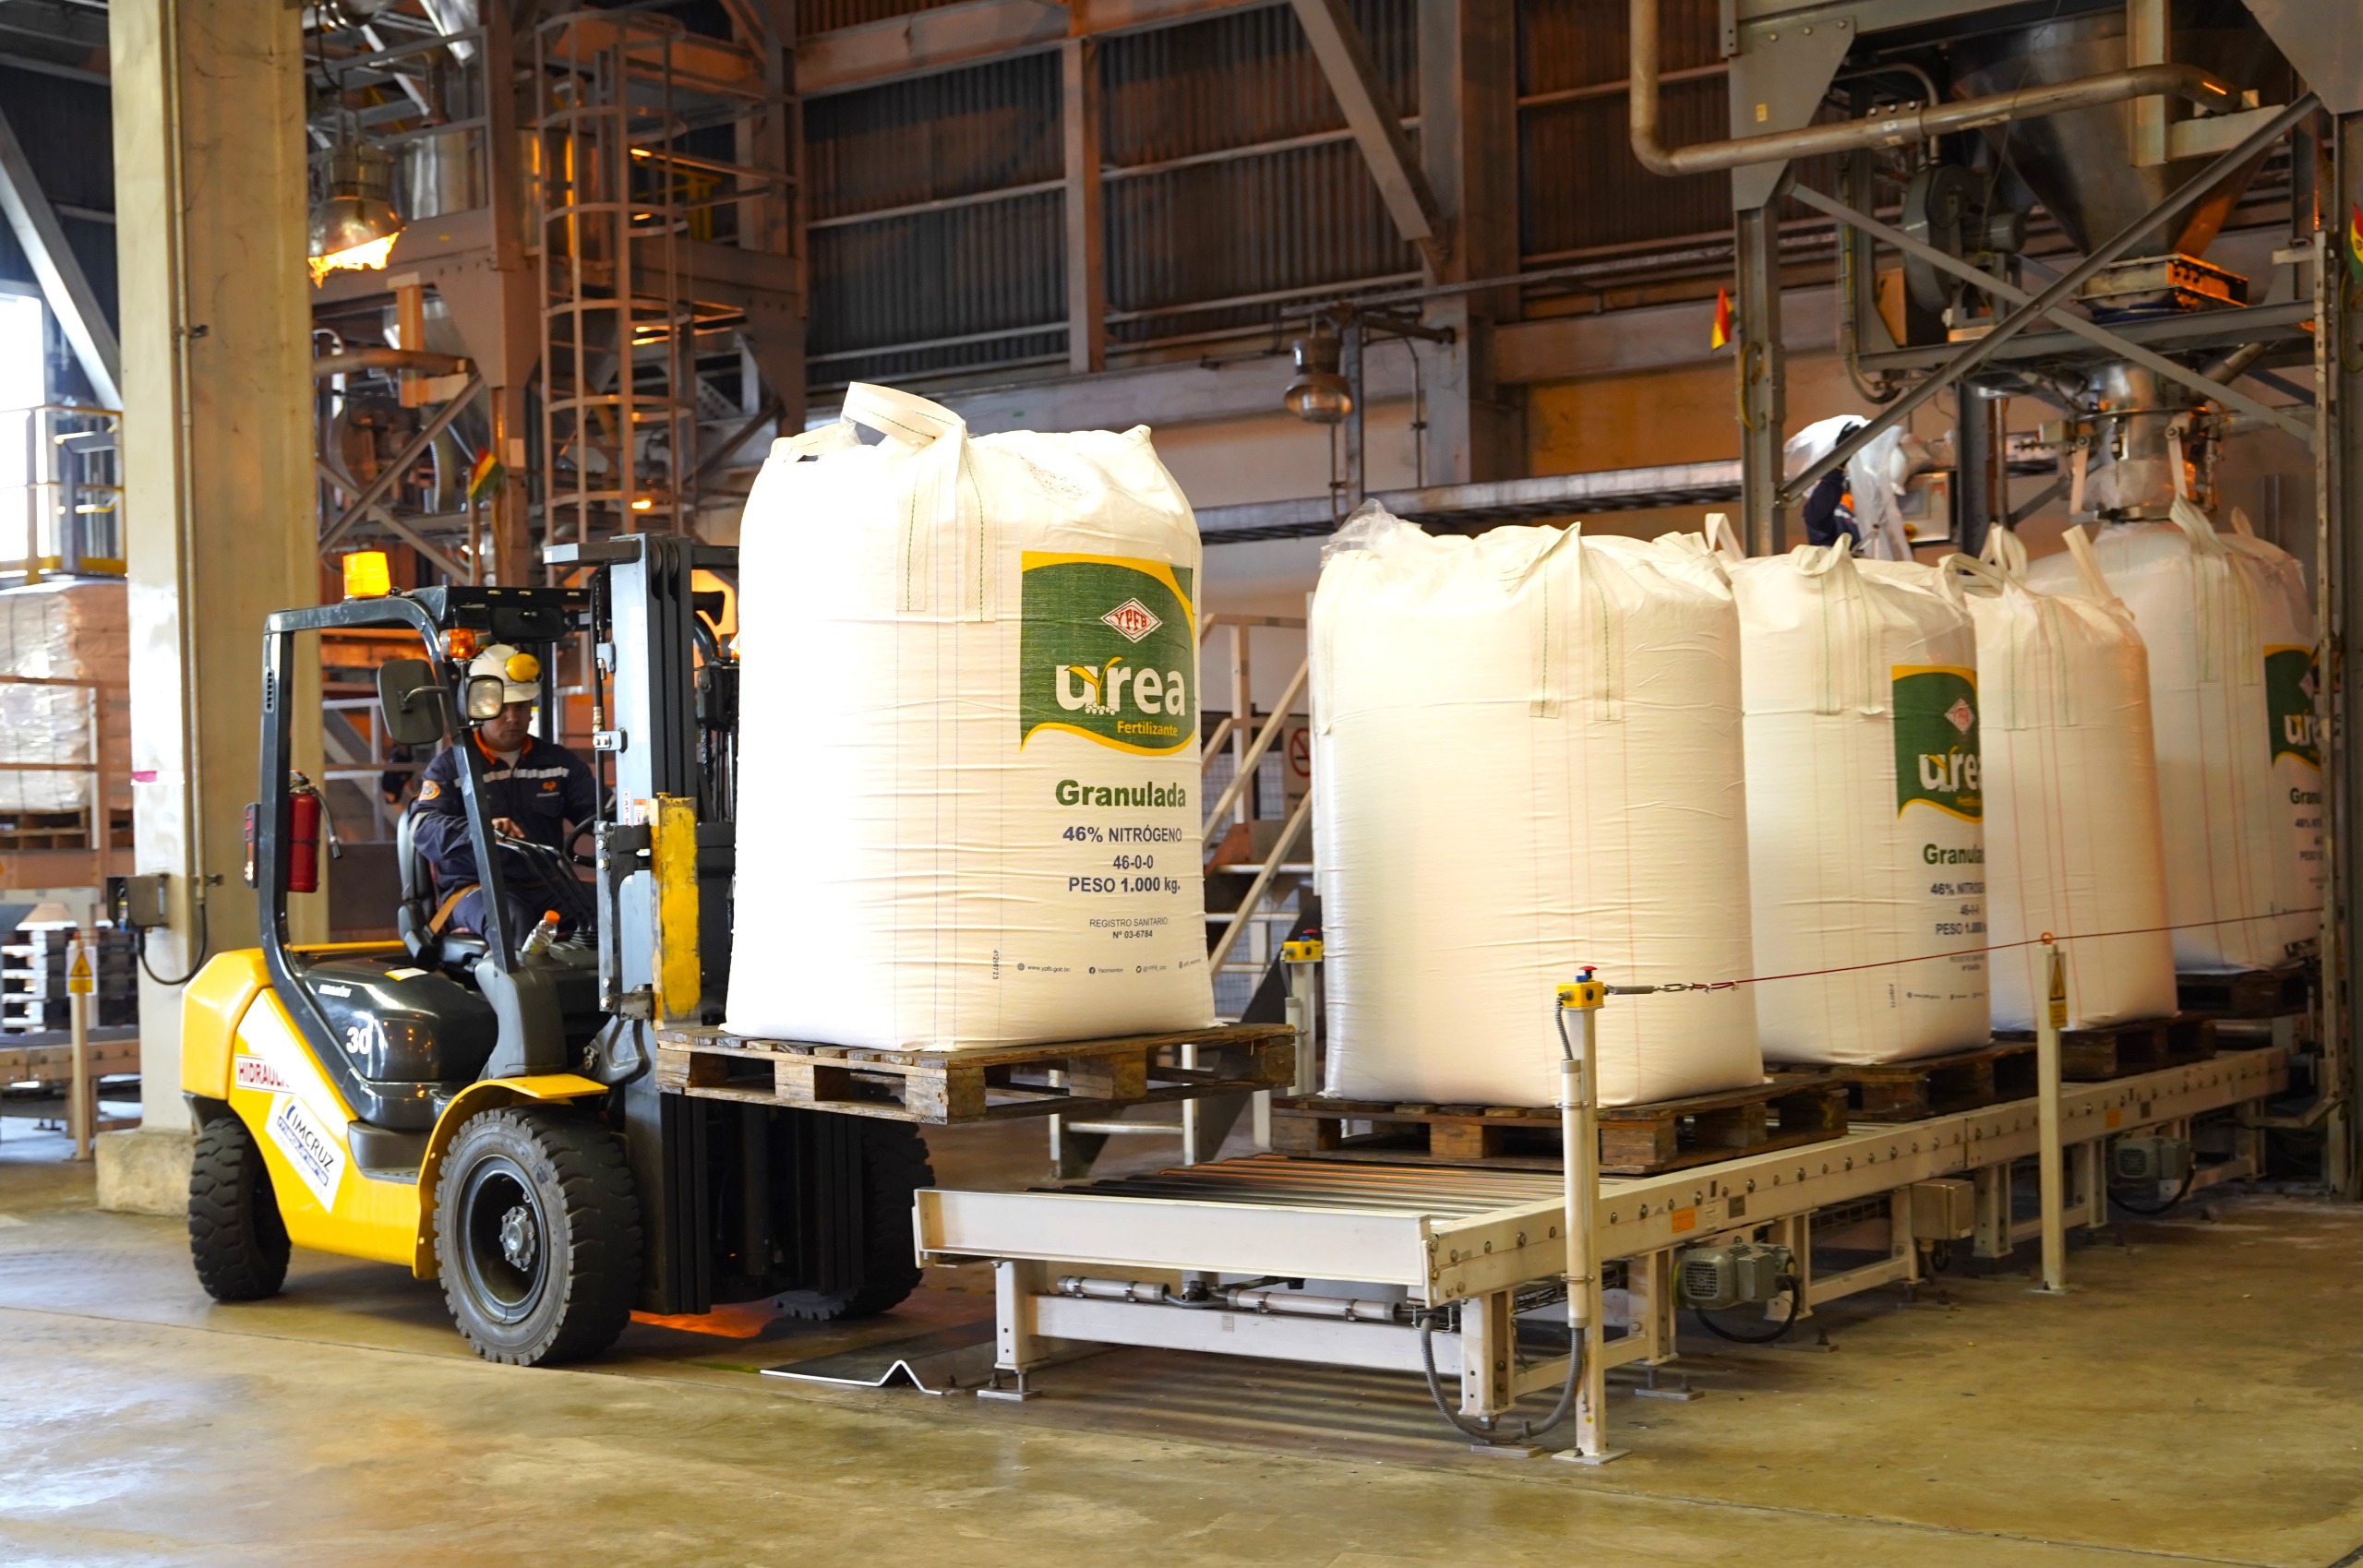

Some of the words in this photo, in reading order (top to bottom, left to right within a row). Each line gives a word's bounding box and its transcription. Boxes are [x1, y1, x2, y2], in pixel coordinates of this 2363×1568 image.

[1114, 608, 1147, 631] YPFB
[1055, 659, 1186, 717] urea
[1117, 721, 1178, 736] Fertilizante
[1055, 779, 1186, 808] Granulada
[1062, 826, 1103, 843] 46%
[1109, 824, 1182, 843] NITRÓGENO
[1112, 855, 1154, 869] 46-0-0
[1068, 877, 1116, 892] PESO
[1121, 877, 1160, 892] 1.000
[1164, 877, 1181, 894] kg.
[1089, 918, 1133, 928] REGISTRO
[1134, 916, 1169, 927] SANITARIO
[1936, 922, 1963, 935] PESO
[1123, 929, 1153, 939] 03-6784
[346, 1026, 370, 1055] 30
[292, 1113, 334, 1173] IMCRUZ
